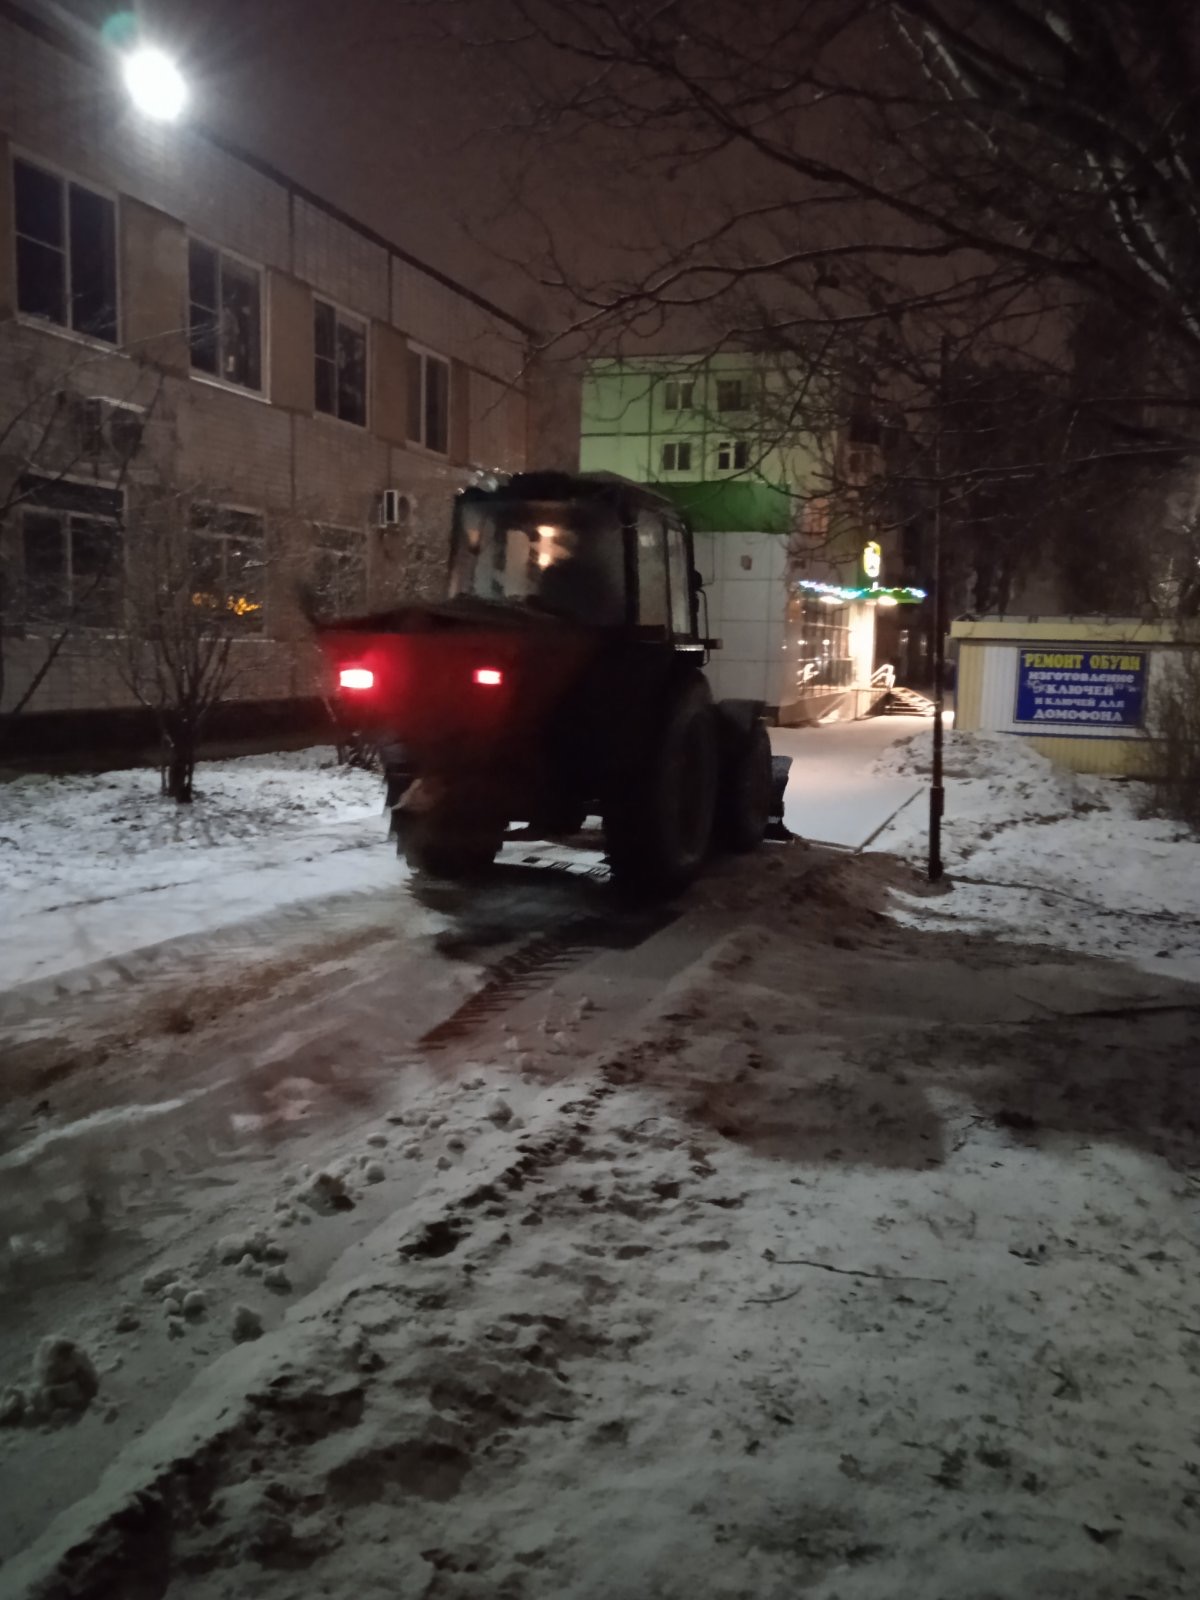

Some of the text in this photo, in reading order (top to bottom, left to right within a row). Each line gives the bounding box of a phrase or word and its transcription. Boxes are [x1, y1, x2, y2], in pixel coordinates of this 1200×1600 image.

[1025, 654, 1140, 670] РЕМОНТ ОБУВИ
[1046, 683, 1114, 696] КЛЮЧЕЙ
[1045, 697, 1096, 707] КЛЮЧЕЙ
[1098, 700, 1125, 708] ДЛЯ
[1033, 709, 1122, 721] ДОМОФОНА
